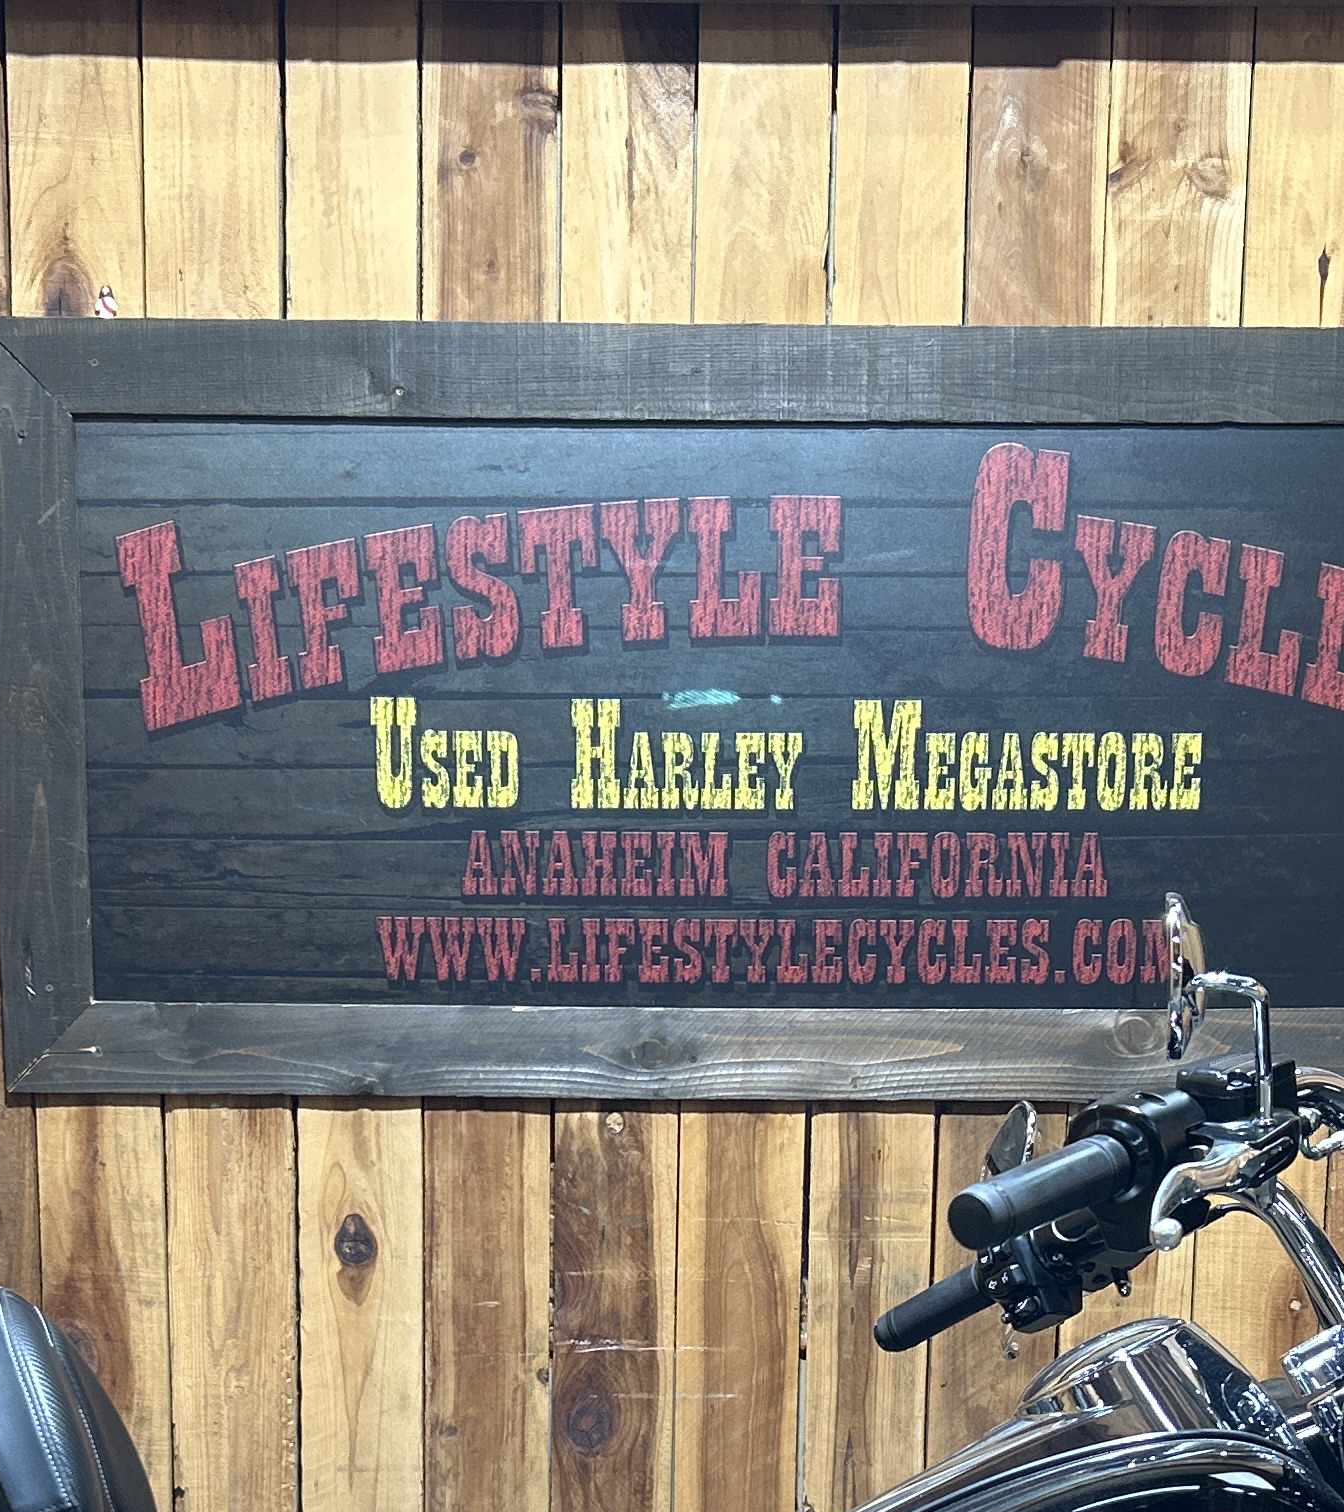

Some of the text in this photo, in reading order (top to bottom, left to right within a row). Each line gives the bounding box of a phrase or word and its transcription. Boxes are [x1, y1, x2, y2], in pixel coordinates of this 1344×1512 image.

[113, 493, 845, 735] LIFESTYLE
[369, 697, 1203, 812] USED HARLEY MEGASTORE
[461, 830, 1108, 898] ANAHEIM CALIFORNIA
